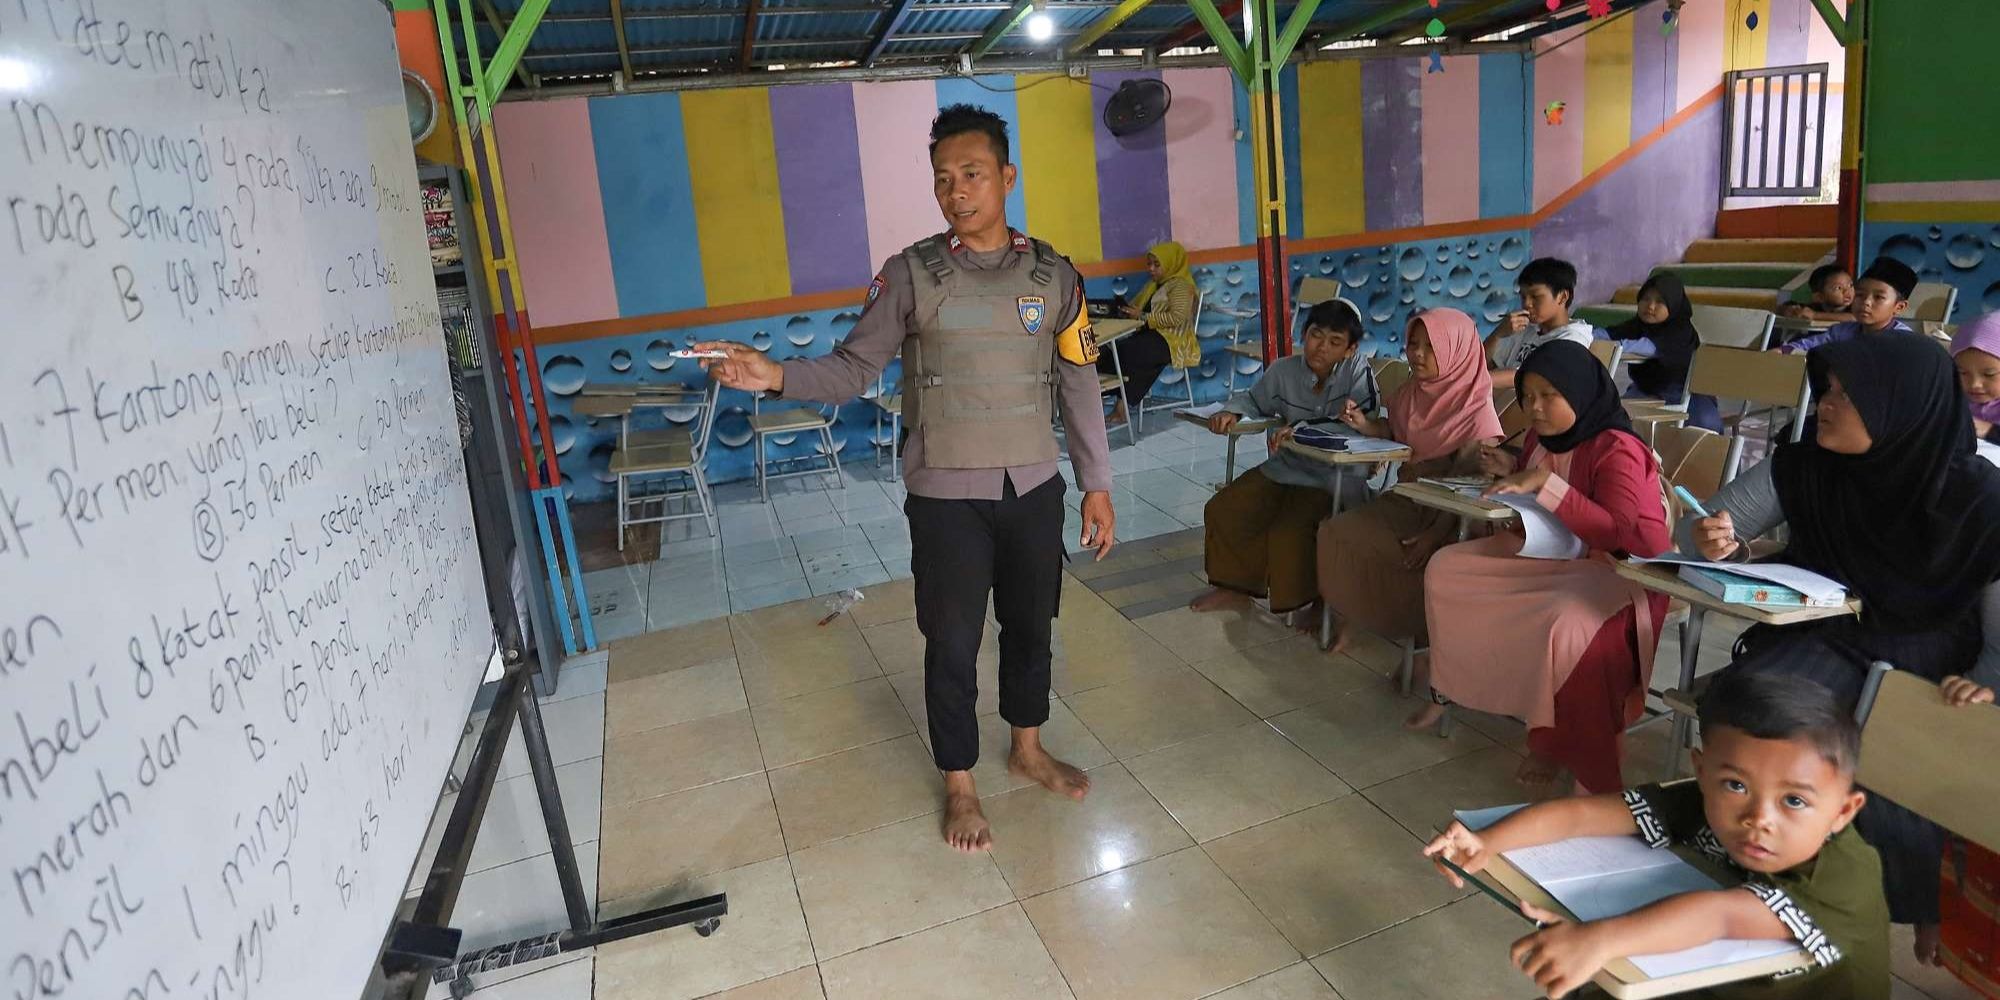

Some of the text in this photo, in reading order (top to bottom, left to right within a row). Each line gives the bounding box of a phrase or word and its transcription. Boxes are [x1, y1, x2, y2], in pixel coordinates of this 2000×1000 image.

[11, 98, 213, 205] Mempunyai
[222, 136, 241, 187] 4
[8, 184, 97, 254] roda
[347, 252, 371, 288] 32
[33, 368, 80, 471] 7
[128, 636, 154, 699] 8
[12, 767, 133, 918] merah
[139, 713, 199, 787] dan
[207, 667, 225, 714] 6
[221, 762, 309, 908] minggu
[321, 698, 353, 761] ada
